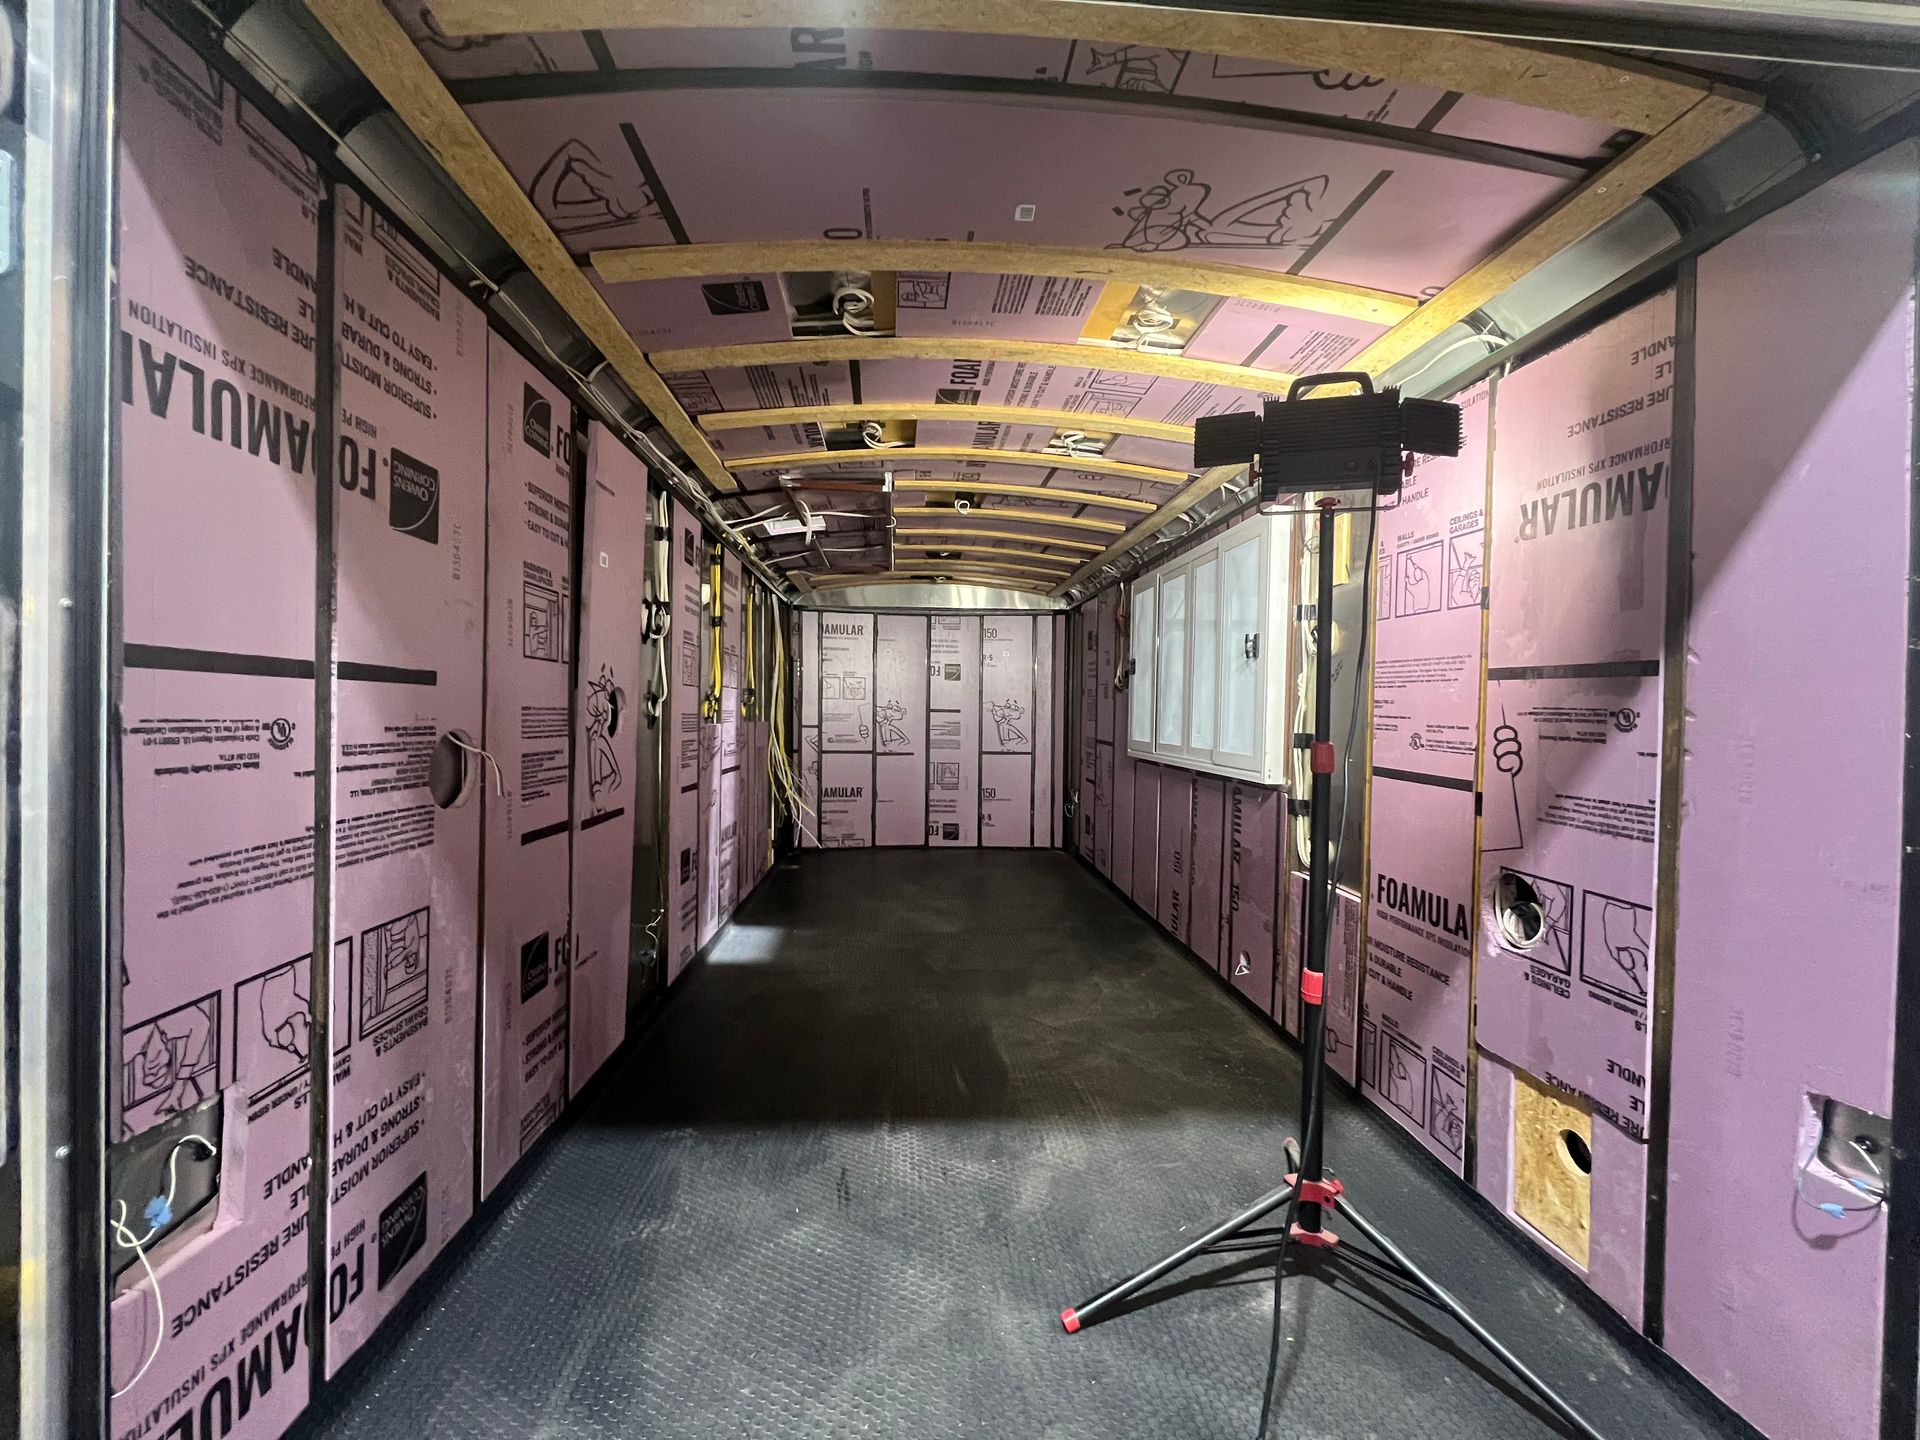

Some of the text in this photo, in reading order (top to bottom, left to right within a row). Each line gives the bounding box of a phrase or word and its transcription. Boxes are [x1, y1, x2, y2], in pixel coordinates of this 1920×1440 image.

[183, 255, 288, 337] RESISTANCE
[129, 300, 216, 361] INSULATION
[368, 313, 390, 339] CUT
[392, 331, 406, 352] TO
[221, 349, 245, 377] XPS
[382, 351, 391, 368] &
[407, 344, 432, 370] EASY
[1654, 360, 1673, 380] LE
[393, 358, 432, 394] STRONG
[121, 331, 319, 477] AMULA
[383, 377, 432, 419] SUPERIOR
[1566, 397, 1644, 438] RESISTANCE
[393, 461, 436, 491] CORNING
[1536, 465, 1585, 491] INSULATION
[1588, 458, 1607, 474] XPS
[393, 475, 428, 501] OWENS
[1402, 487, 1429, 506] HANDLE
[1519, 461, 1669, 542] AMULAR
[1449, 519, 1479, 535] GARAGES
[1450, 511, 1476, 527] CEILINGS
[822, 623, 864, 636] AMULAR
[821, 787, 863, 798] AMULAR
[1377, 873, 1469, 940] FOAMULA
[1406, 955, 1450, 986] RESISTANCE
[1530, 965, 1571, 988] GARAGES
[1386, 978, 1413, 1001] HANDLE
[1531, 975, 1570, 999] CEILINGS
[334, 1073, 420, 1149] EASY TO CUT & H
[380, 1096, 420, 1137] STRONG
[1629, 1095, 1645, 1115] LE
[371, 1129, 378, 1144] &
[372, 1120, 419, 1170] SUPERIOR
[263, 1153, 311, 1199] ANDLE
[289, 1183, 308, 1209] LE
[344, 1219, 366, 1249] HIGH
[171, 1235, 279, 1338] RESISTANCE
[211, 1338, 235, 1370] XPS
